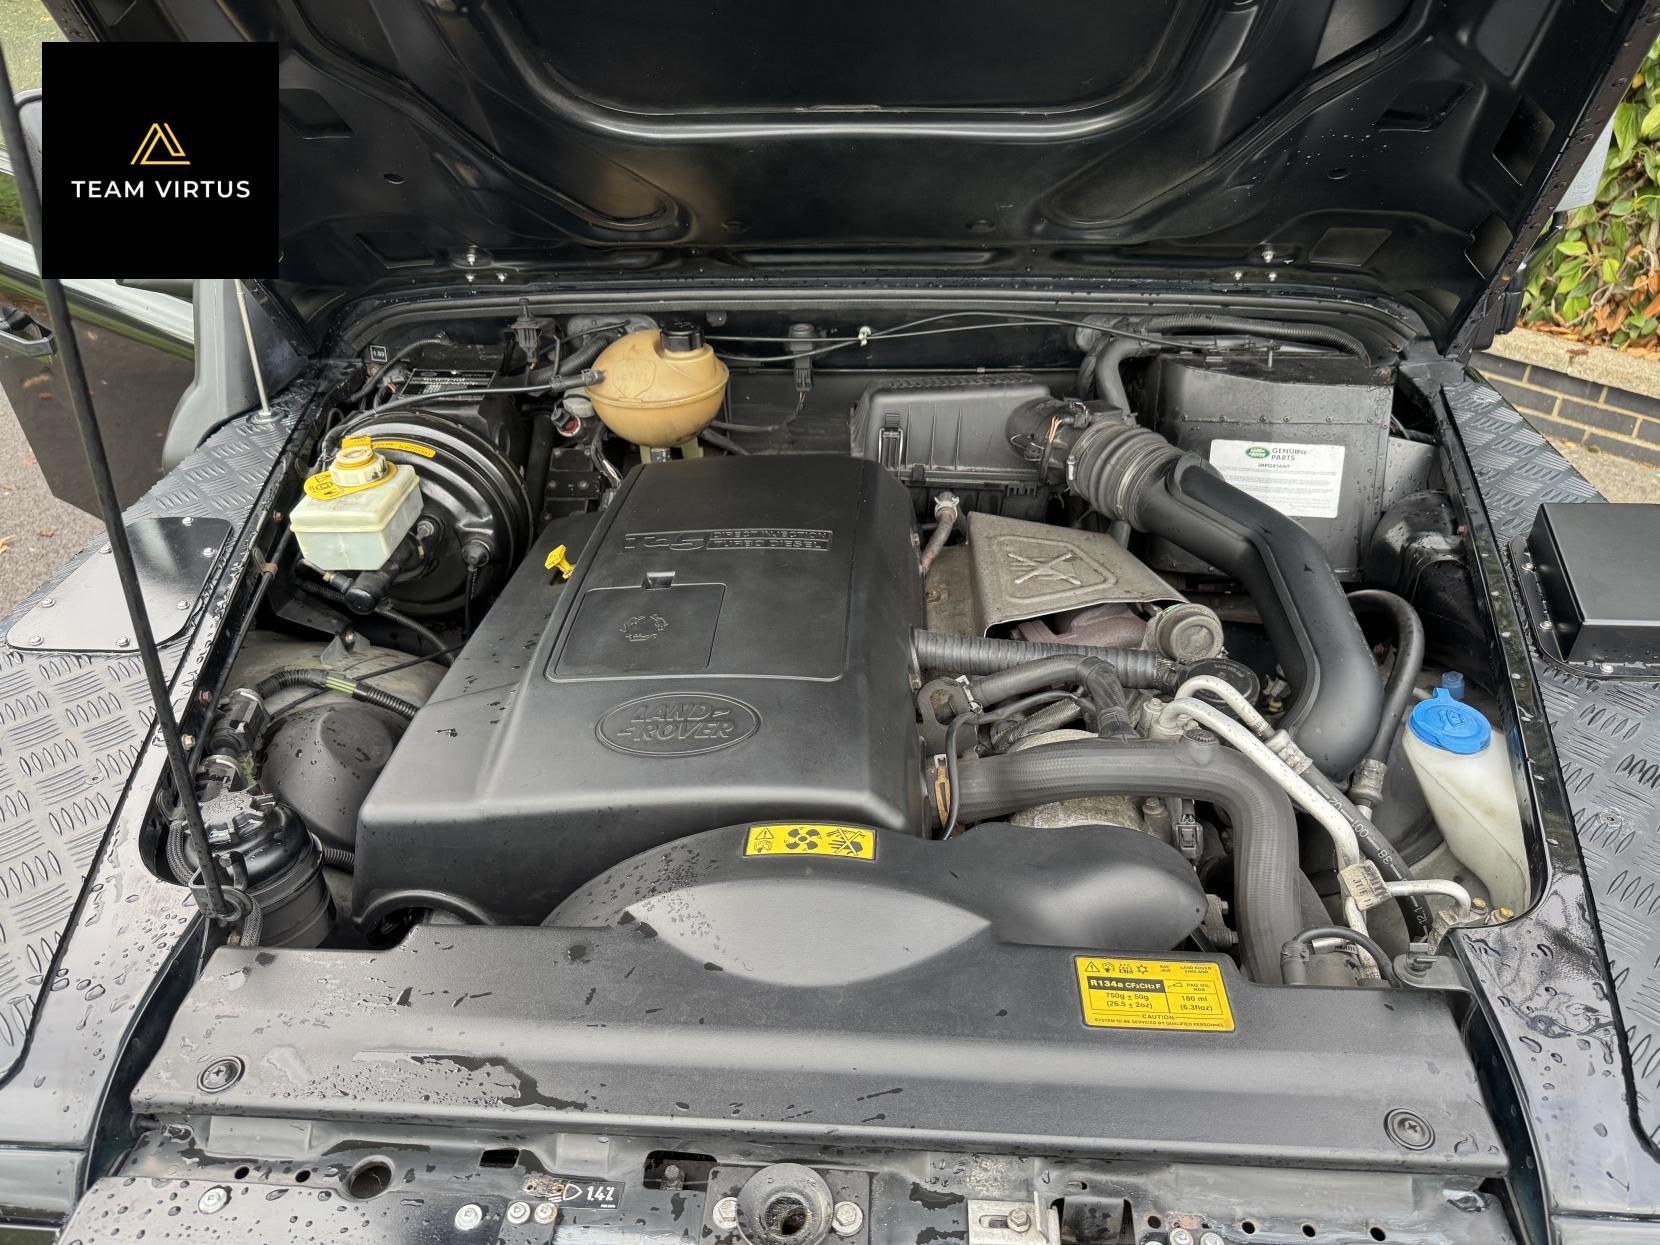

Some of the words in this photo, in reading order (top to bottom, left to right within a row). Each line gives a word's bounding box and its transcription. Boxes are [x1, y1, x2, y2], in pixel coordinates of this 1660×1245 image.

[1271, 447, 1307, 455] GENUINE
[713, 530, 759, 538] DIRECT
[760, 530, 829, 539] INJECTION
[713, 540, 765, 548] TURBO
[769, 540, 822, 549] DIESEL
[631, 703, 713, 722] LAND
[633, 721, 736, 742] ROVER
[1377, 849, 1393, 865] 38
[1090, 979, 1123, 988] R134a
[1106, 992, 1125, 1000] 750g
[1106, 1000, 1126, 1008] (26.5
[587, 1185, 615, 1201] 1.4%
